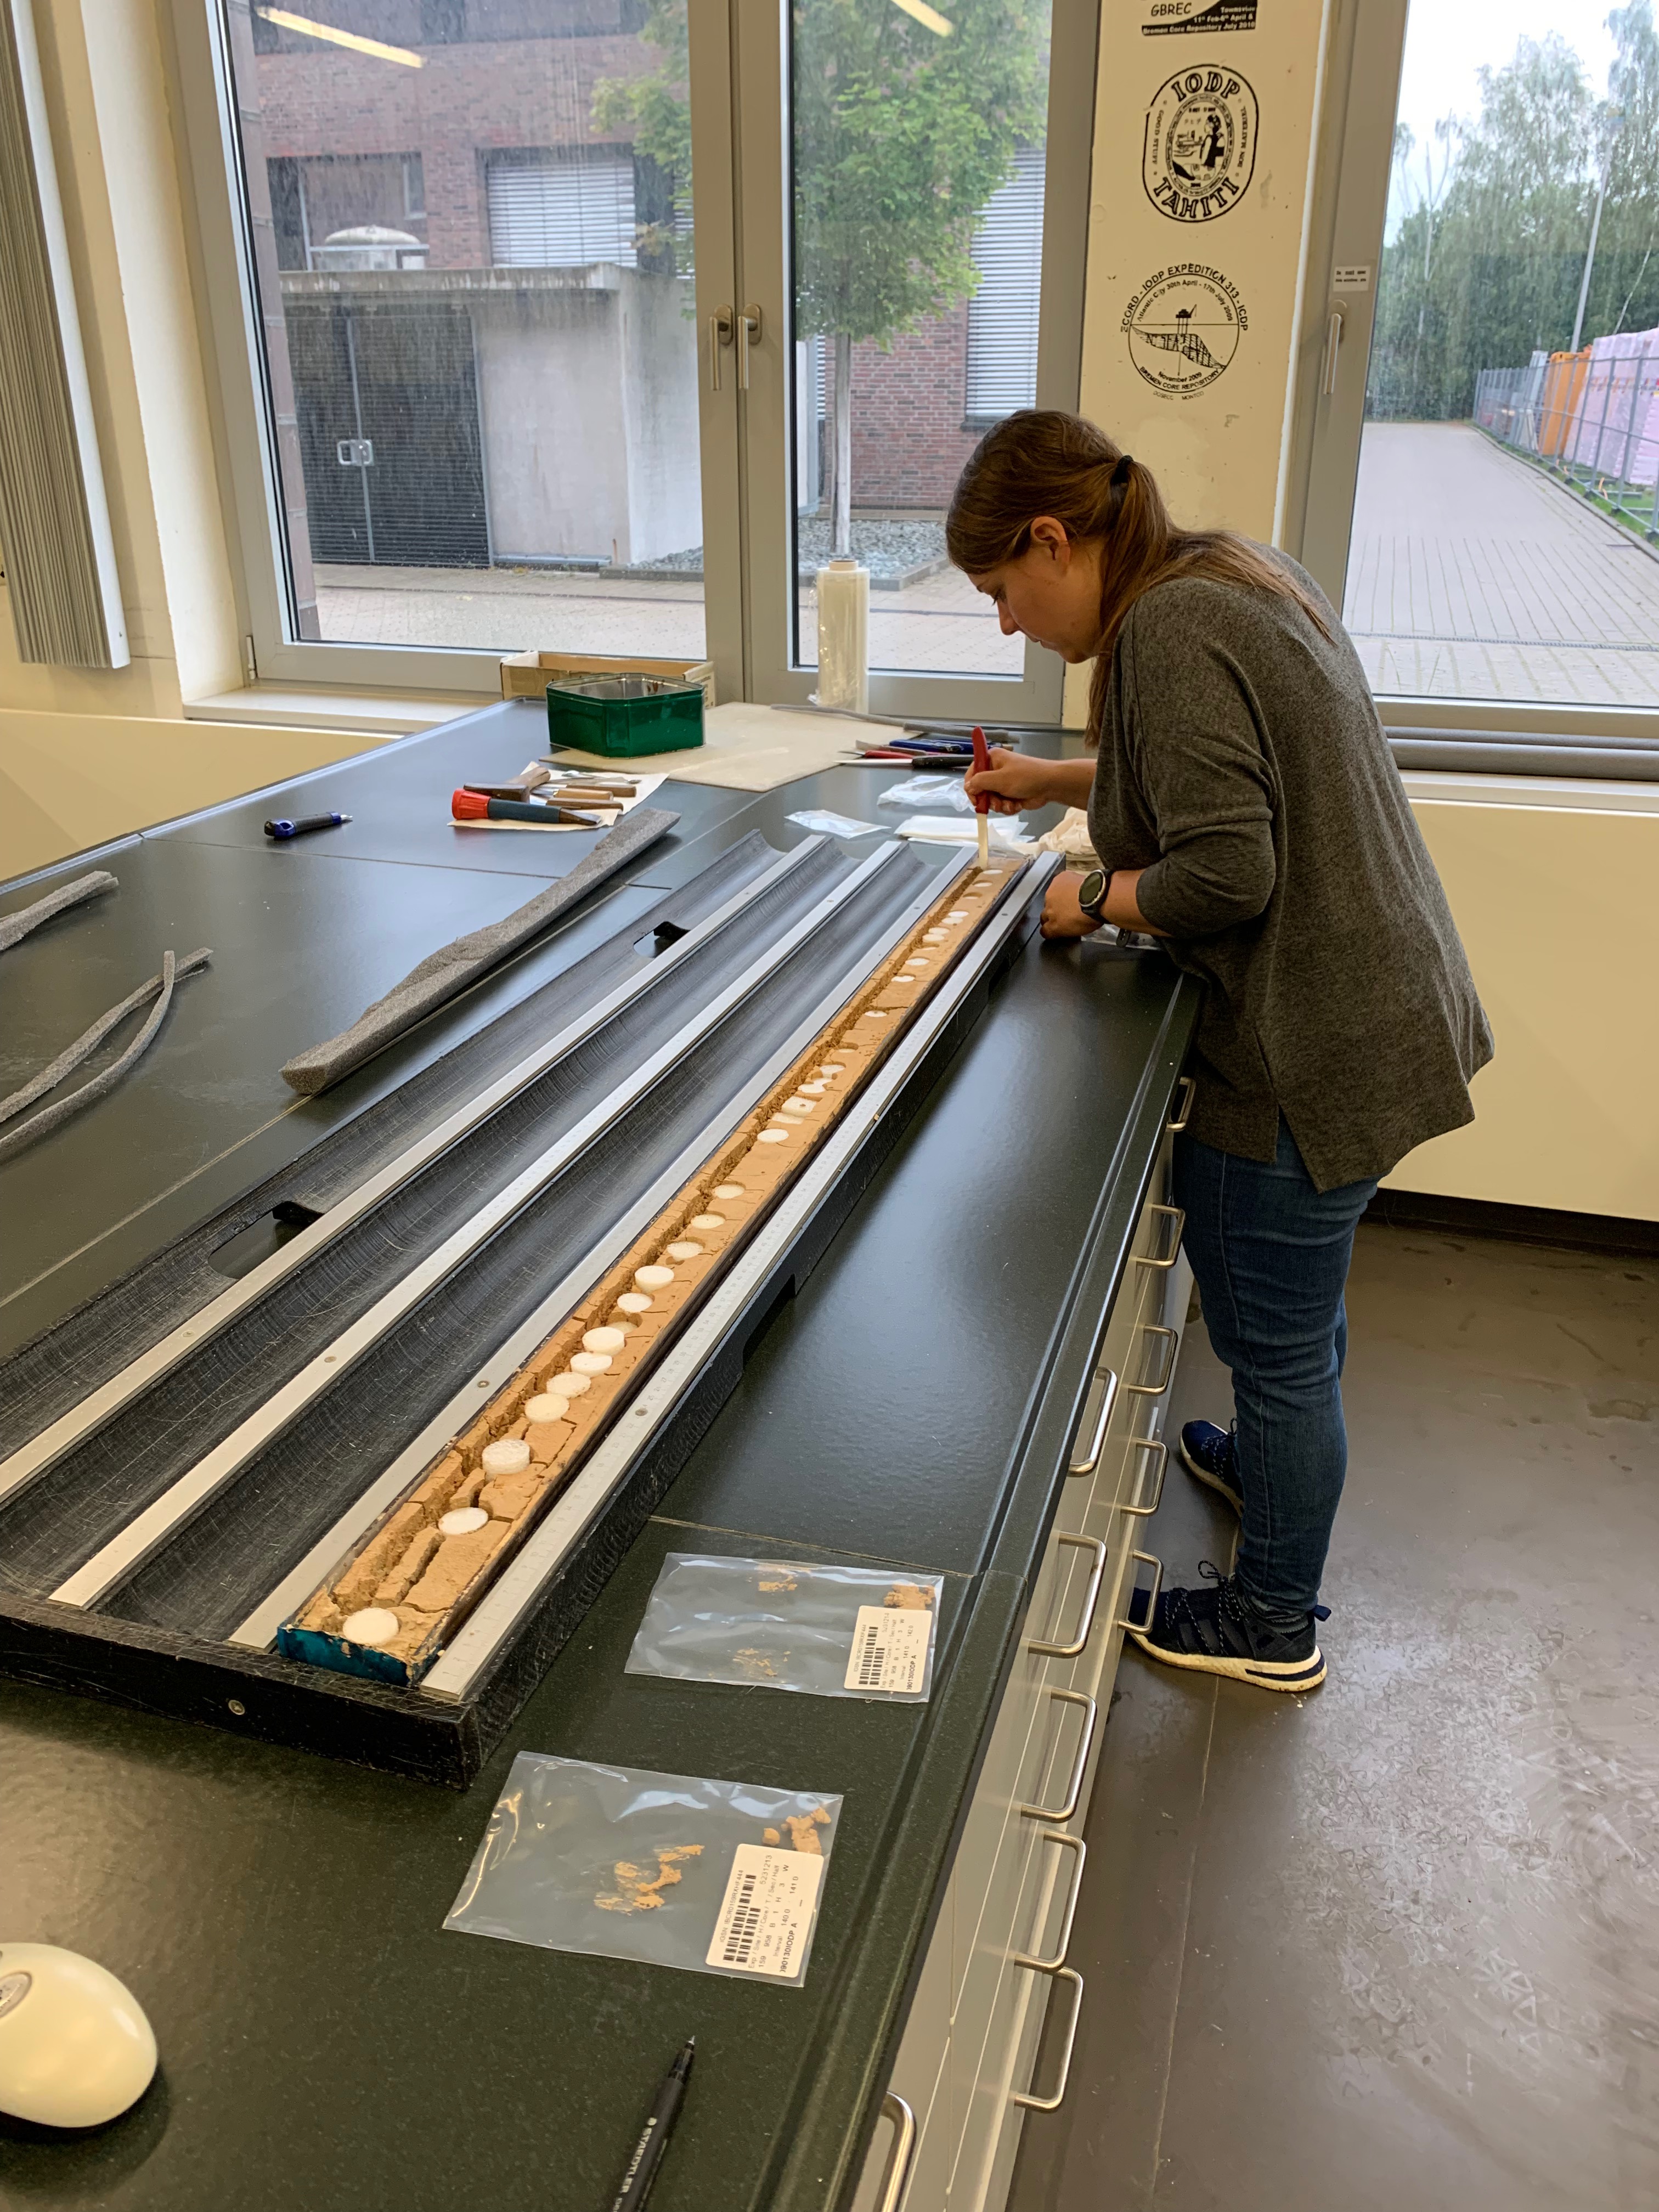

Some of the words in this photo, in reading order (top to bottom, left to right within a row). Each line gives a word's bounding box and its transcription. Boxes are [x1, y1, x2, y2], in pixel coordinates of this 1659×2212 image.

[1151, 3, 1192, 16] GBREC
[1186, 24, 1222, 32] Repository
[1171, 71, 1240, 102] IODP
[1154, 177, 1240, 218] TAHITI
[1120, 295, 1139, 332] ECORD
[1142, 271, 1164, 291] IODP
[1167, 263, 1227, 284] EXPEDITION
[1225, 281, 1239, 298] 313
[1237, 304, 1249, 331] ICDP
[1137, 297, 1154, 322] Atlantic
[1203, 283, 1216, 294] 17th
[1223, 305, 1233, 321] 2009
[1139, 366, 1162, 385] BREMEN
[1182, 368, 1219, 390] REPOSITORY
[1158, 371, 1187, 382] November
[1189, 371, 1202, 381] 2009
[759, 1855, 772, 1884] 5231213
[748, 1957, 757, 1968] Exp
[760, 1910, 769, 1923] Core
[764, 1935, 772, 1946] 958
[773, 1936, 782, 1956] Interval
